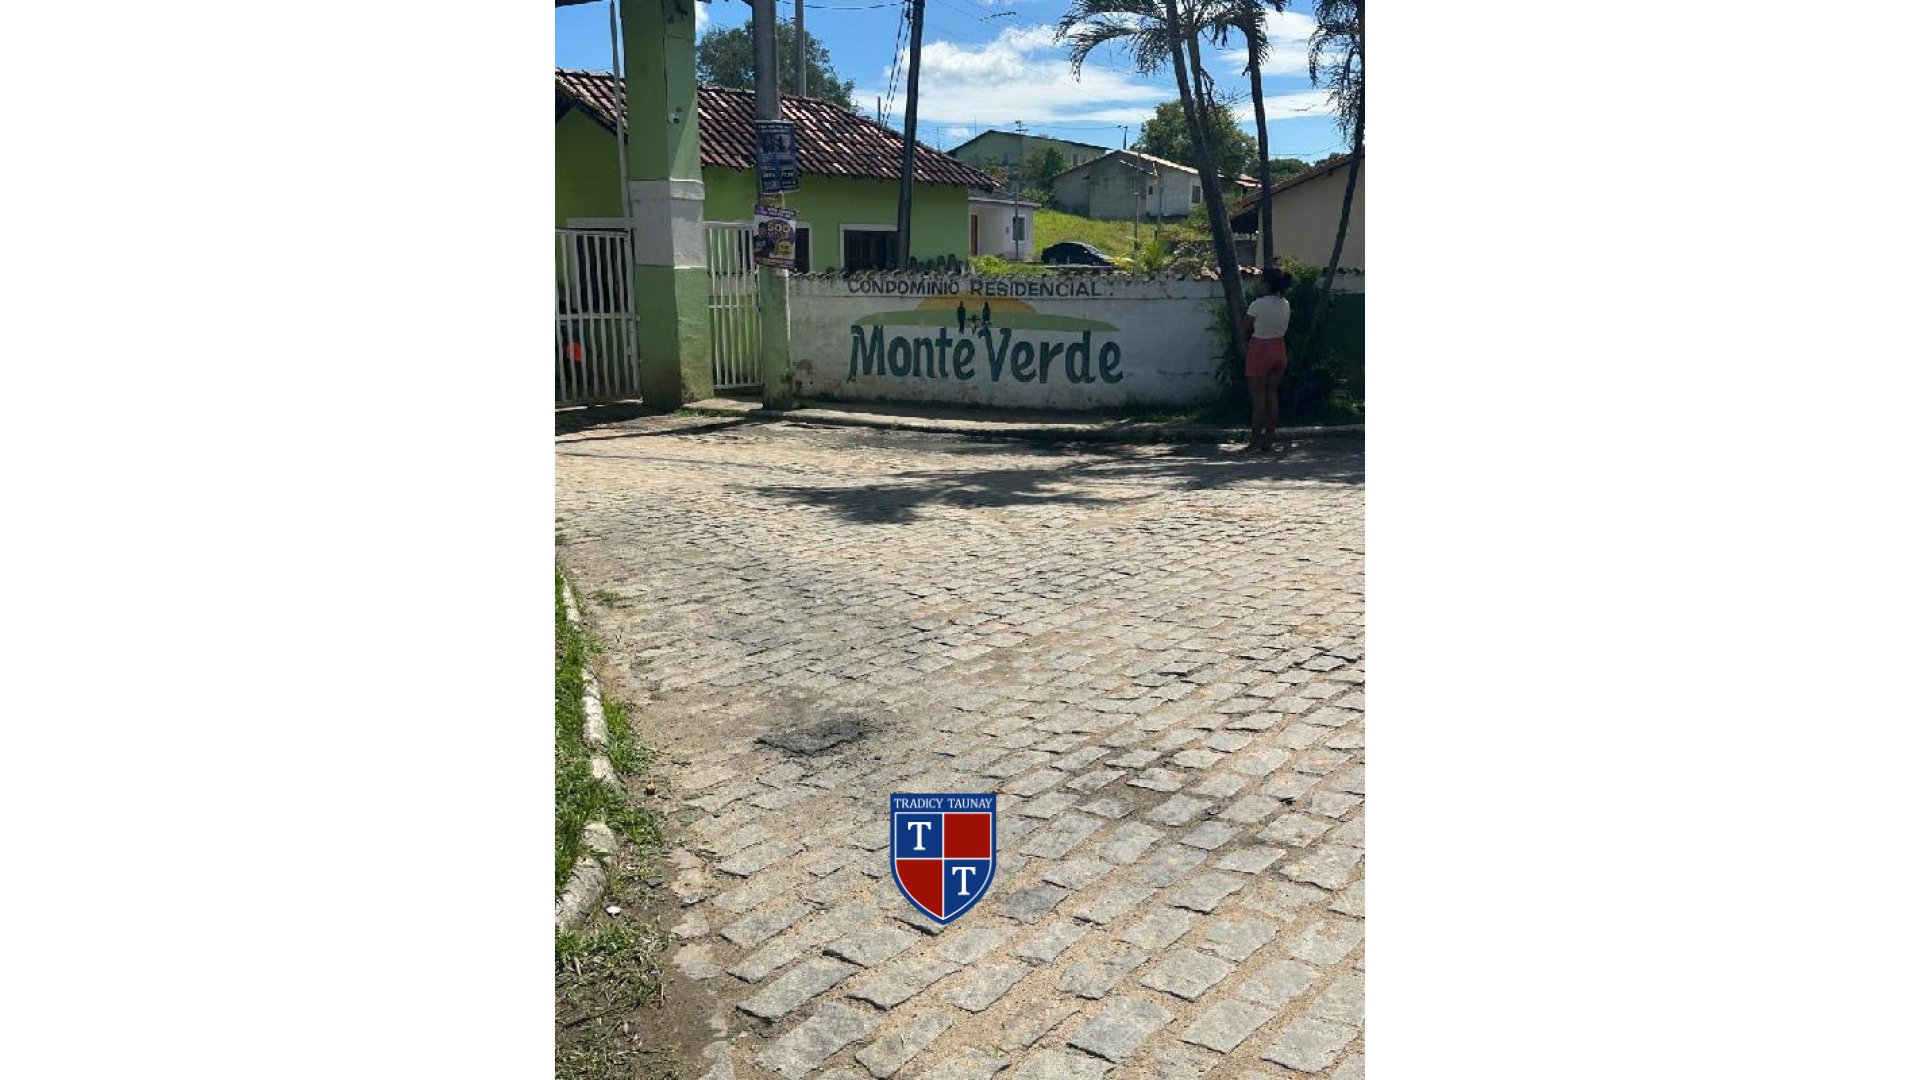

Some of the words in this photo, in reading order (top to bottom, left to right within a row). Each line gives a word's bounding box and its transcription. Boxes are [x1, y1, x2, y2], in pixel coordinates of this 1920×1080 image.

[970, 279, 1101, 297] RESIDENCIAL
[846, 324, 976, 383] Monte
[978, 326, 1124, 384] Verde
